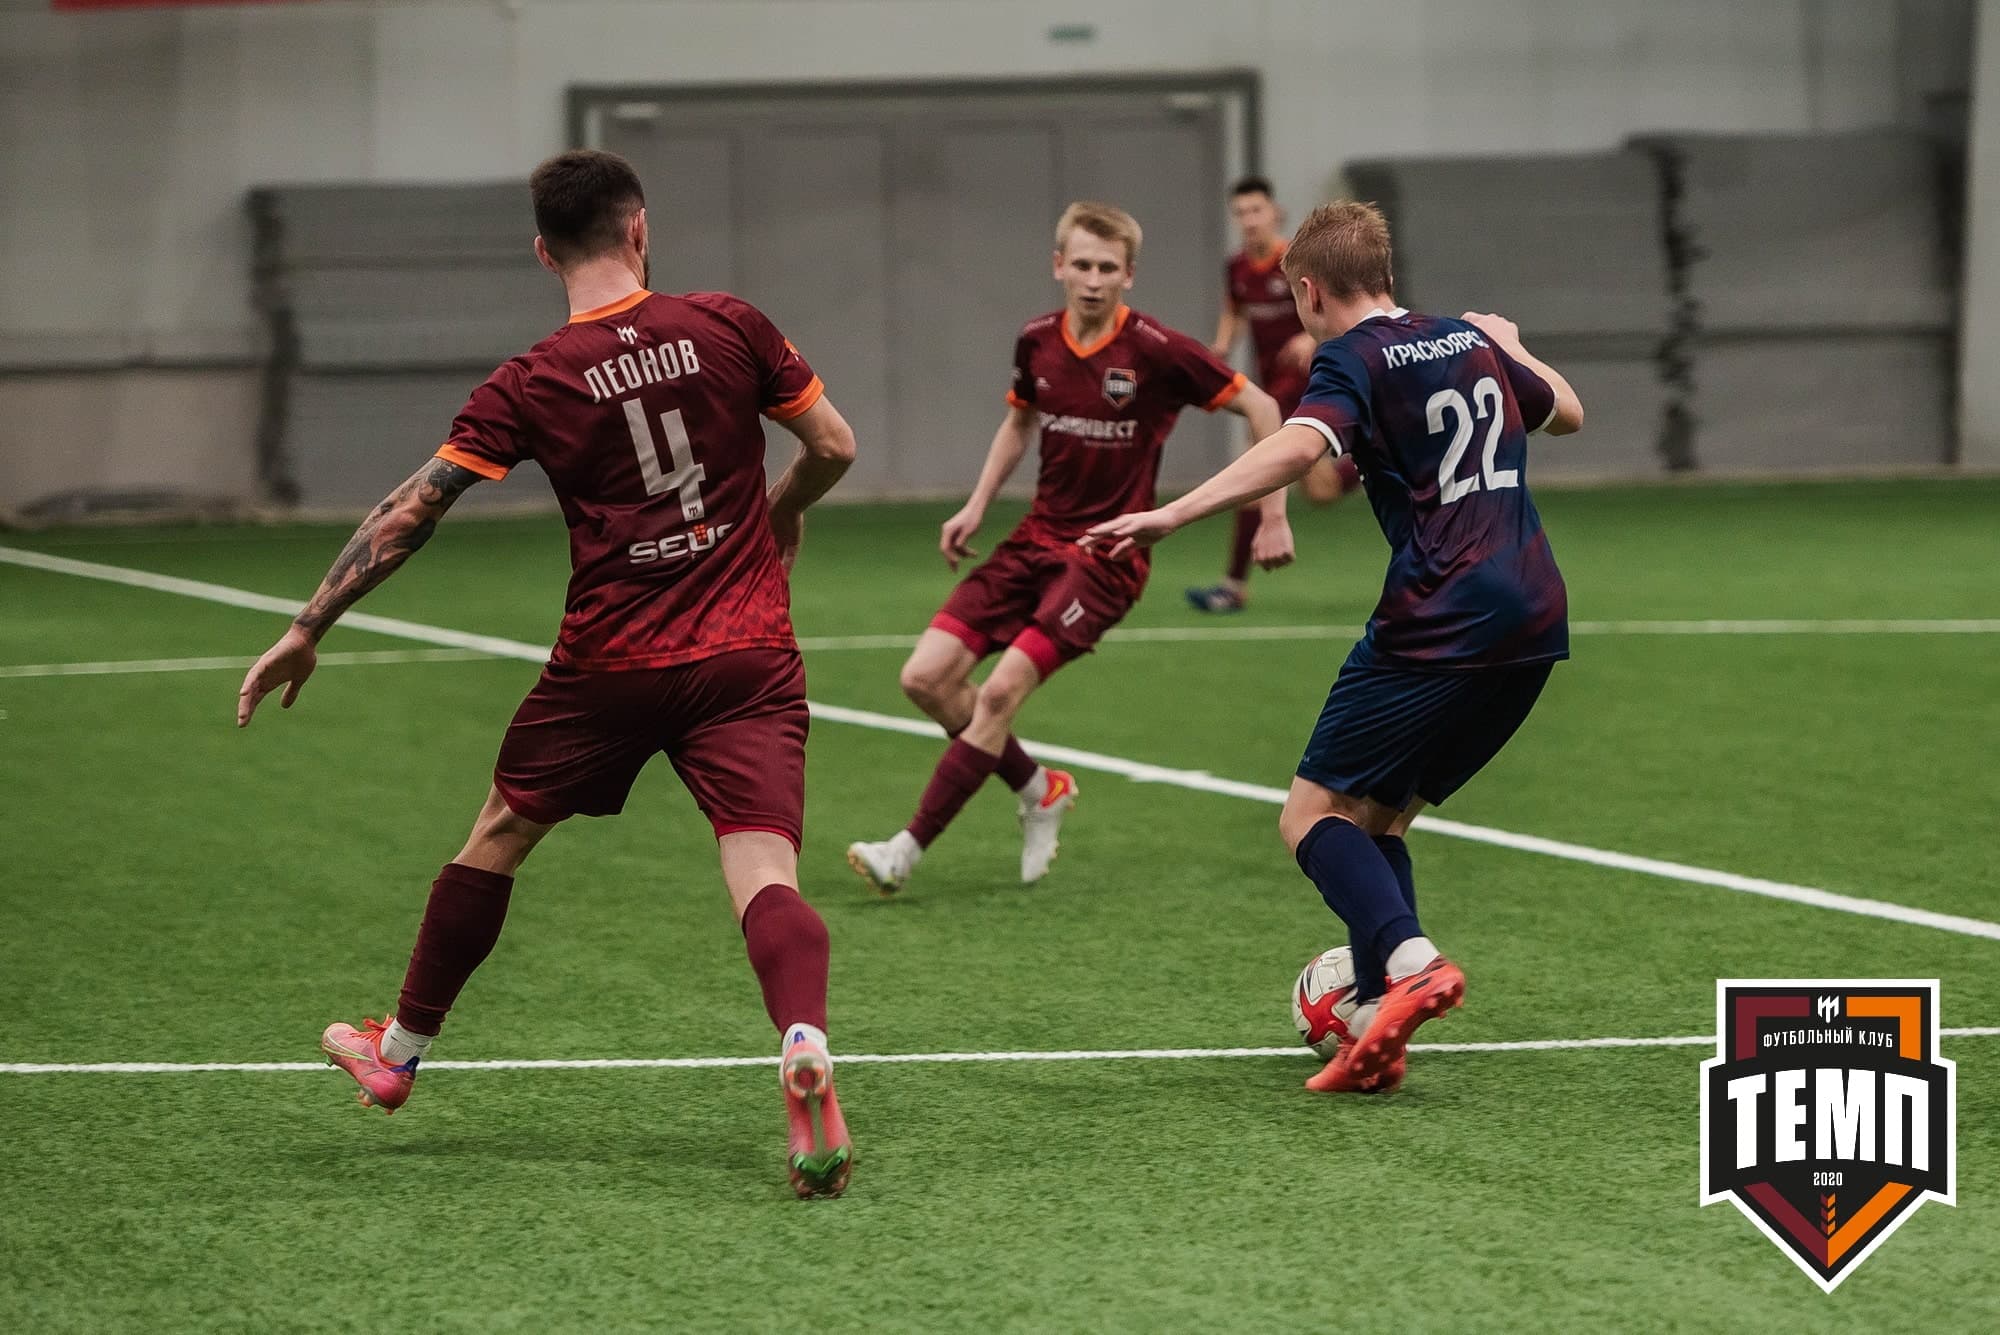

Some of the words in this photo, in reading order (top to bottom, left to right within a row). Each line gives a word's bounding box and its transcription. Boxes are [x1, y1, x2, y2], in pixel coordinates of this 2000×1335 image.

[584, 339, 700, 403] ЛЕОНОВ
[622, 397, 706, 521] 4
[1425, 376, 1519, 505] 22
